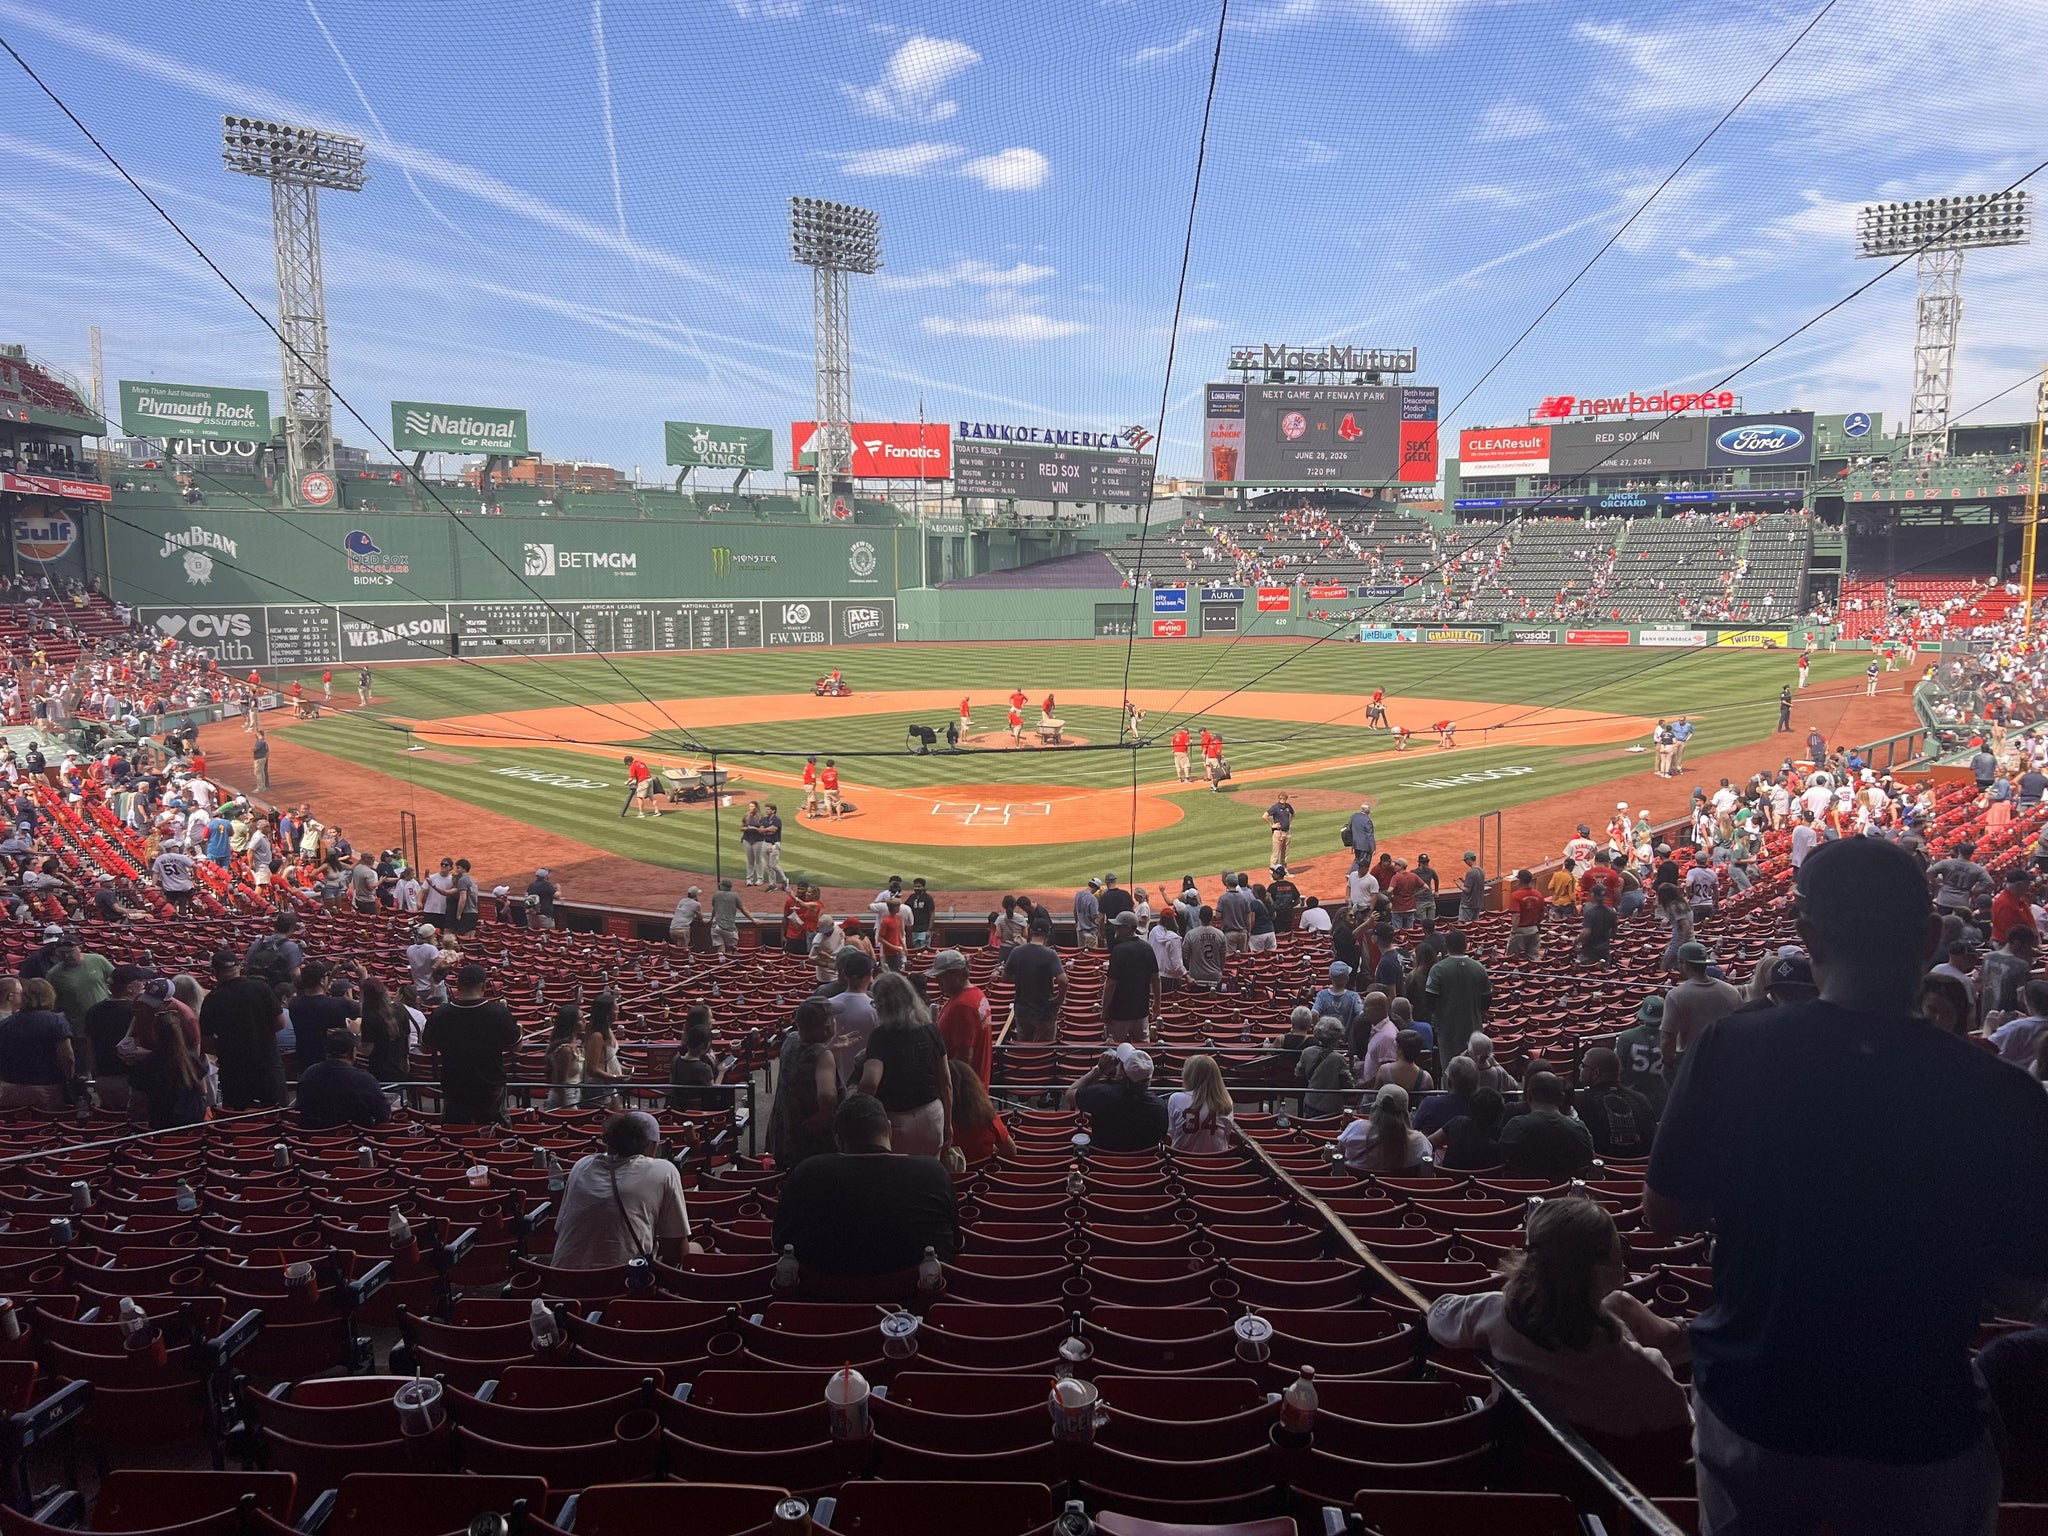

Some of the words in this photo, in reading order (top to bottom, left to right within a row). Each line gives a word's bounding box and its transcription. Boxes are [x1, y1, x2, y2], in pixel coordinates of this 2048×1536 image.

[1263, 343, 1417, 370] MassMutual
[1262, 391, 1284, 399] NEXT
[1287, 391, 1310, 399] GAME
[1314, 391, 1325, 400] AT
[1327, 392, 1360, 400] FENWAY
[1363, 392, 1385, 400] PARK
[138, 397, 212, 417] Plymouth
[216, 402, 255, 420] Rock
[960, 421, 1010, 441] BANK
[1016, 426, 1038, 442] OF
[1043, 429, 1119, 448] AMERICA
[1595, 434, 1614, 442] RED
[1618, 432, 1638, 442] SOX
[1642, 432, 1660, 440] WIN
[1733, 429, 1785, 450] Ford
[461, 438, 478, 446] Car
[481, 439, 512, 448] Rental
[693, 439, 748, 454] DRAFT
[1406, 440, 1431, 452] SEAT
[1469, 437, 1541, 450] CLEAResult
[885, 444, 941, 458] Fanatics
[1316, 452, 1328, 461] 28,
[1404, 451, 1432, 462] GEEK
[701, 452, 746, 466] KINGS
[1620, 458, 1631, 466] 27,
[1039, 463, 1058, 476] RED
[1061, 465, 1080, 478] SOX
[1306, 468, 1324, 476] 7:20
[1326, 468, 1336, 476] PM
[1051, 482, 1069, 494] WIN
[1872, 490, 1881, 500] 4
[1890, 490, 1896, 500] 1
[1923, 489, 1942, 500] 27
[1600, 500, 1647, 508] ORCHARD
[14, 522, 71, 541] Gulf
[352, 555, 380, 564] RED
[382, 555, 409, 564] SOX
[559, 552, 638, 568] BETMGM
[732, 553, 778, 562] MONSTER
[354, 576, 384, 585] BIDMC
[850, 609, 880, 623] ACE
[188, 614, 252, 638] CVS
[852, 620, 880, 631] TICKET
[792, 632, 824, 643] WEBB
[1364, 630, 1392, 640] jetBlue
[1428, 631, 1464, 641] GRANITE
[1464, 630, 1483, 641] CITY
[1515, 630, 1550, 640] wasabi
[1730, 636, 1760, 645] TWISTED
[489, 766, 611, 790] WHOOP
[1399, 766, 1537, 790] WHOOP
[1575, 850, 1592, 862] 24
[164, 864, 180, 876] 51
[1204, 944, 1214, 960] 2
[1631, 1042, 1664, 1074] 52
[1182, 1107, 1218, 1136] 34
[49, 1404, 64, 1420] KK
